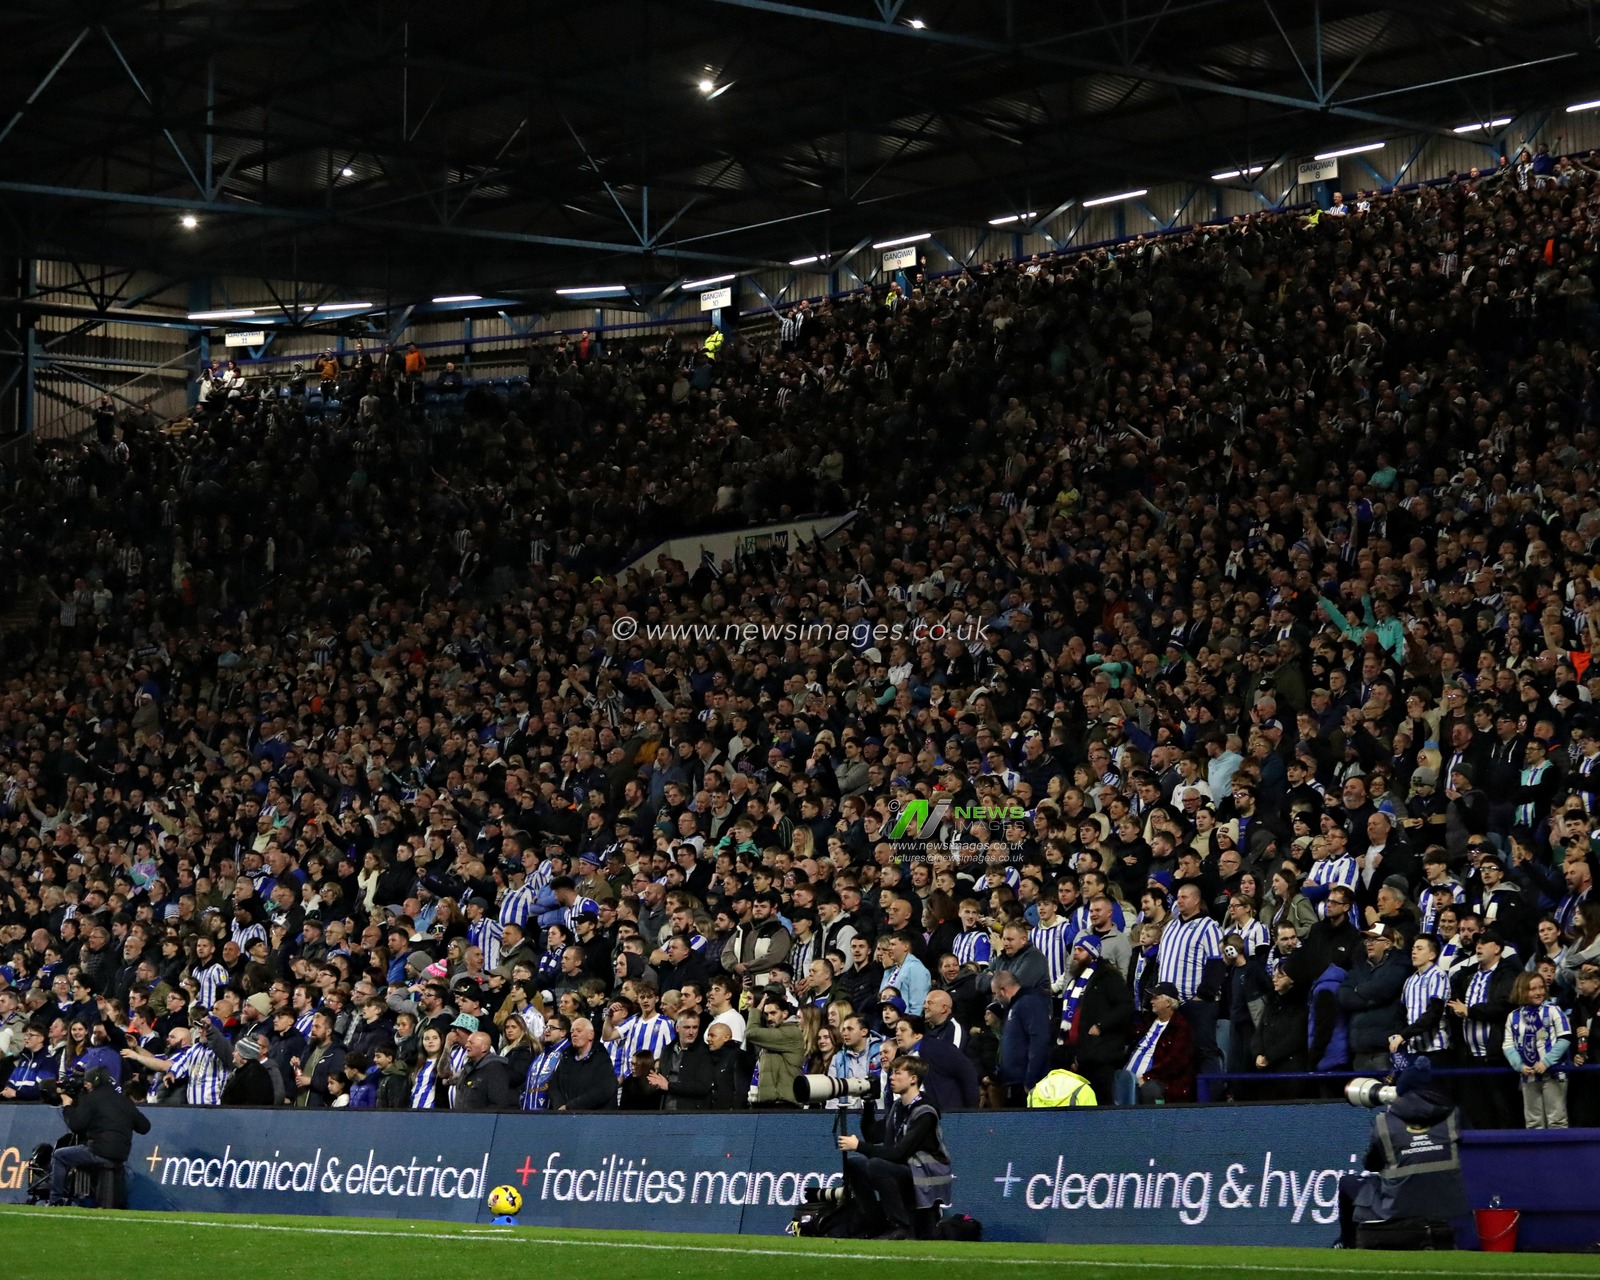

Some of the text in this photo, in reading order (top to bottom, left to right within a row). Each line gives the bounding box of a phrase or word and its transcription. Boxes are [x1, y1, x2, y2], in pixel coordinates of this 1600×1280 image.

[1299, 159, 1335, 174] GANGWAY
[1315, 171, 1321, 179] 8
[884, 248, 914, 262] GANGWAY
[1401, 1144, 1444, 1155] PHOTOGRAPHER
[1409, 1140, 1434, 1148] OFFICIAL
[0, 1146, 33, 1189] Gr
[161, 1144, 490, 1200] mechanical & electrical
[540, 1151, 686, 1204] facilities
[1025, 1155, 1212, 1225] cleaning
[1218, 1163, 1254, 1209] &
